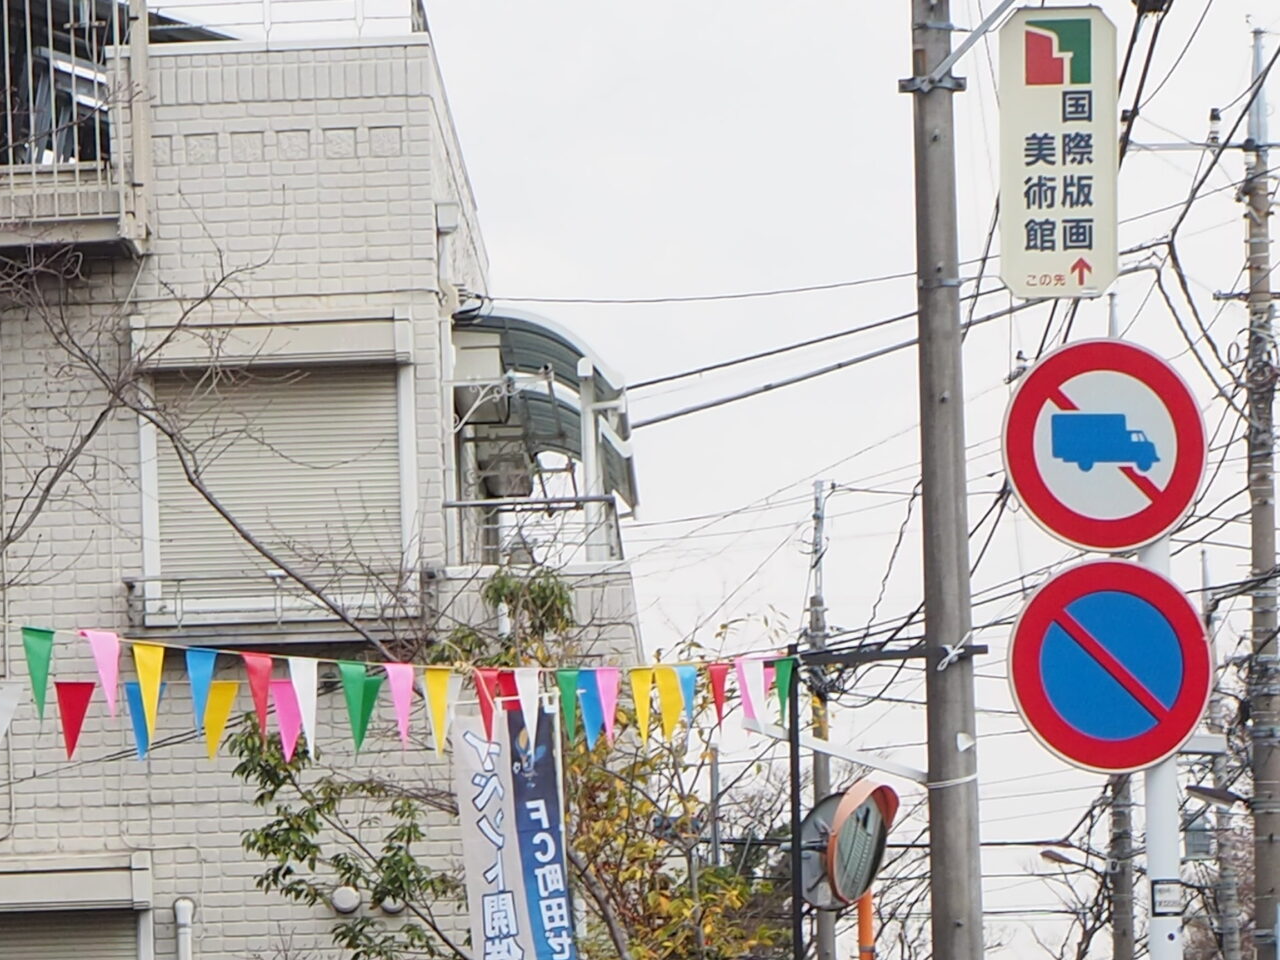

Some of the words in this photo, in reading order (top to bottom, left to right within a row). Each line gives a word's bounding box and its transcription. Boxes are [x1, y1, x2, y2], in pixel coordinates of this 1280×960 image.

[1024, 133, 1057, 252] 美術館
[1062, 90, 1093, 251] 国際版画
[1026, 273, 1066, 287] この先
